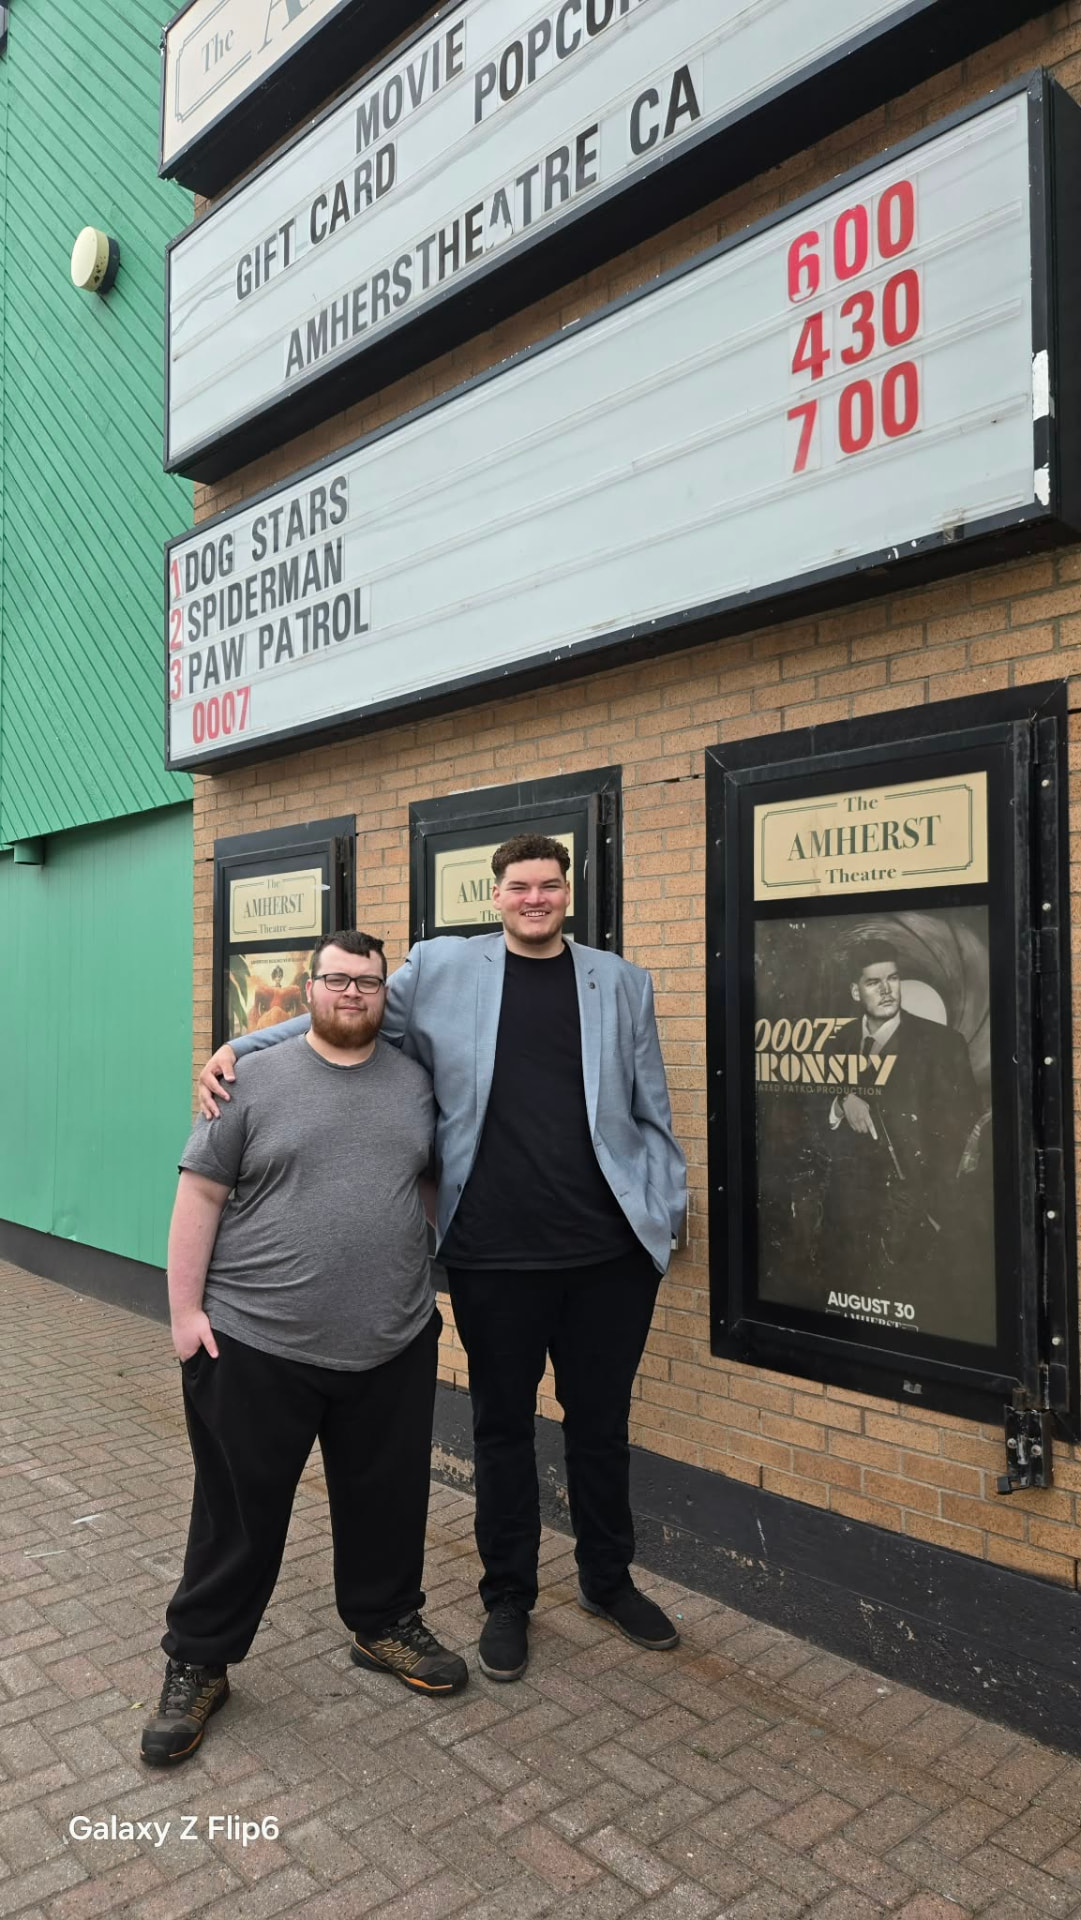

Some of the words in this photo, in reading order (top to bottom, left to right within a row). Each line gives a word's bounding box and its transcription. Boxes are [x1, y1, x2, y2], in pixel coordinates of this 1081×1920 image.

[201, 29, 234, 73] The
[355, 18, 466, 154] MOVIE
[628, 63, 702, 156] CA
[235, 217, 295, 300] GIFT
[309, 142, 396, 245] CARD
[473, 0, 642, 124] POPCO
[791, 269, 920, 381] 430
[170, 559, 182, 599] 1
[185, 533, 234, 594] DOG
[251, 475, 348, 562] STARS
[170, 608, 183, 651] 2
[187, 536, 343, 642] SPIDERMAN
[170, 658, 182, 700] 3
[188, 633, 245, 694] PAW
[258, 588, 369, 670] PATROL
[192, 686, 250, 745] 0007
[787, 814, 941, 862] AMHERST
[843, 795, 879, 813] The
[242, 892, 305, 919] AMHERST
[825, 865, 897, 885] Theatre
[827, 1290, 891, 1316] AUGUST
[893, 1301, 916, 1320] 30
